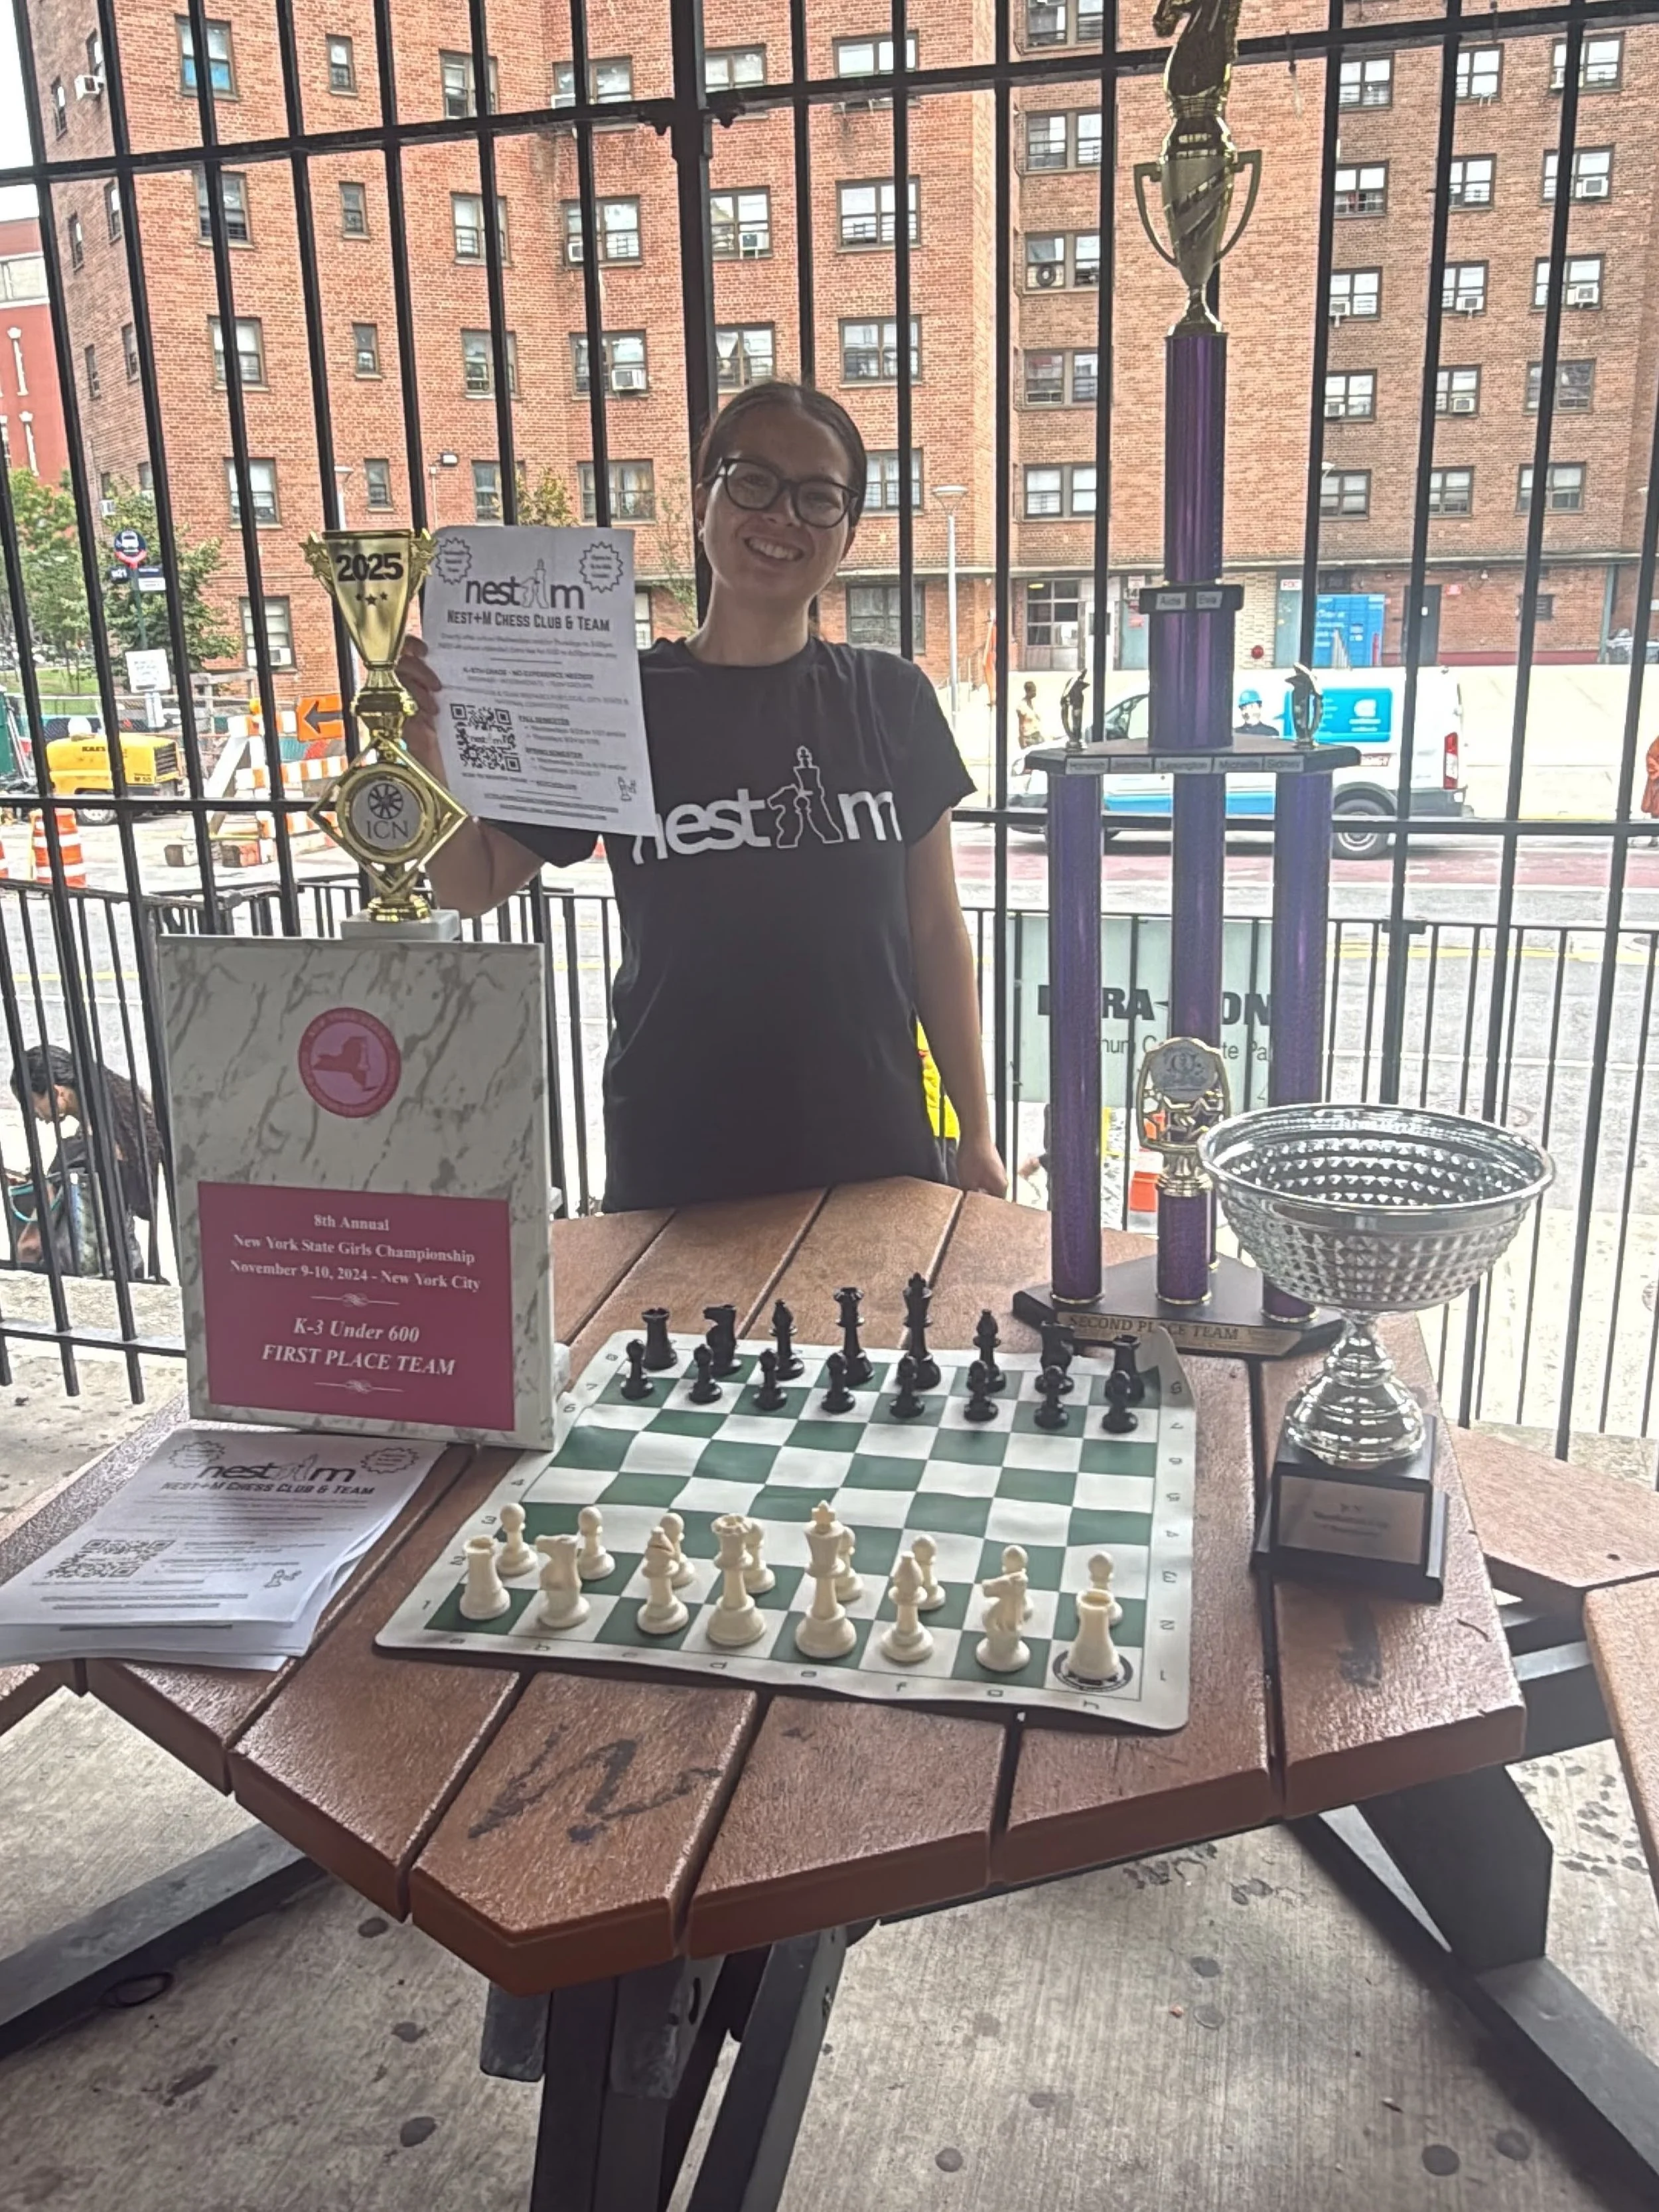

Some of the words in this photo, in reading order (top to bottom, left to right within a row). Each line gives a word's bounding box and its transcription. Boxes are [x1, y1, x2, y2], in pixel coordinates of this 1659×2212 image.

[336, 552, 404, 581] 2025
[465, 575, 521, 607] nest
[550, 583, 585, 610] m
[565, 615, 573, 630] &
[366, 819, 409, 840] ICN
[838, 790, 902, 841] m
[314, 1214, 336, 1228] 8th
[340, 1216, 390, 1231] Annual
[234, 1234, 261, 1248] New
[266, 1236, 299, 1251] York
[301, 1238, 334, 1253] State
[338, 1242, 372, 1256] Girls
[376, 1244, 476, 1266] Championship
[230, 1259, 298, 1277] November
[301, 1264, 334, 1280] 9-10,
[337, 1267, 368, 1282] 2024
[381, 1270, 409, 1284] New
[414, 1272, 448, 1288] York
[452, 1275, 481, 1293] City
[293, 1317, 324, 1335] K-3
[329, 1320, 384, 1340] Under
[388, 1325, 420, 1343] 600
[1069, 1314, 1133, 1333] SECOND
[1193, 1325, 1239, 1341] TEAM
[261, 1343, 323, 1364] FIRST
[324, 1349, 392, 1370] PLACE
[396, 1355, 457, 1376] TEAM
[198, 1462, 274, 1479] nest
[308, 1467, 357, 1483] m
